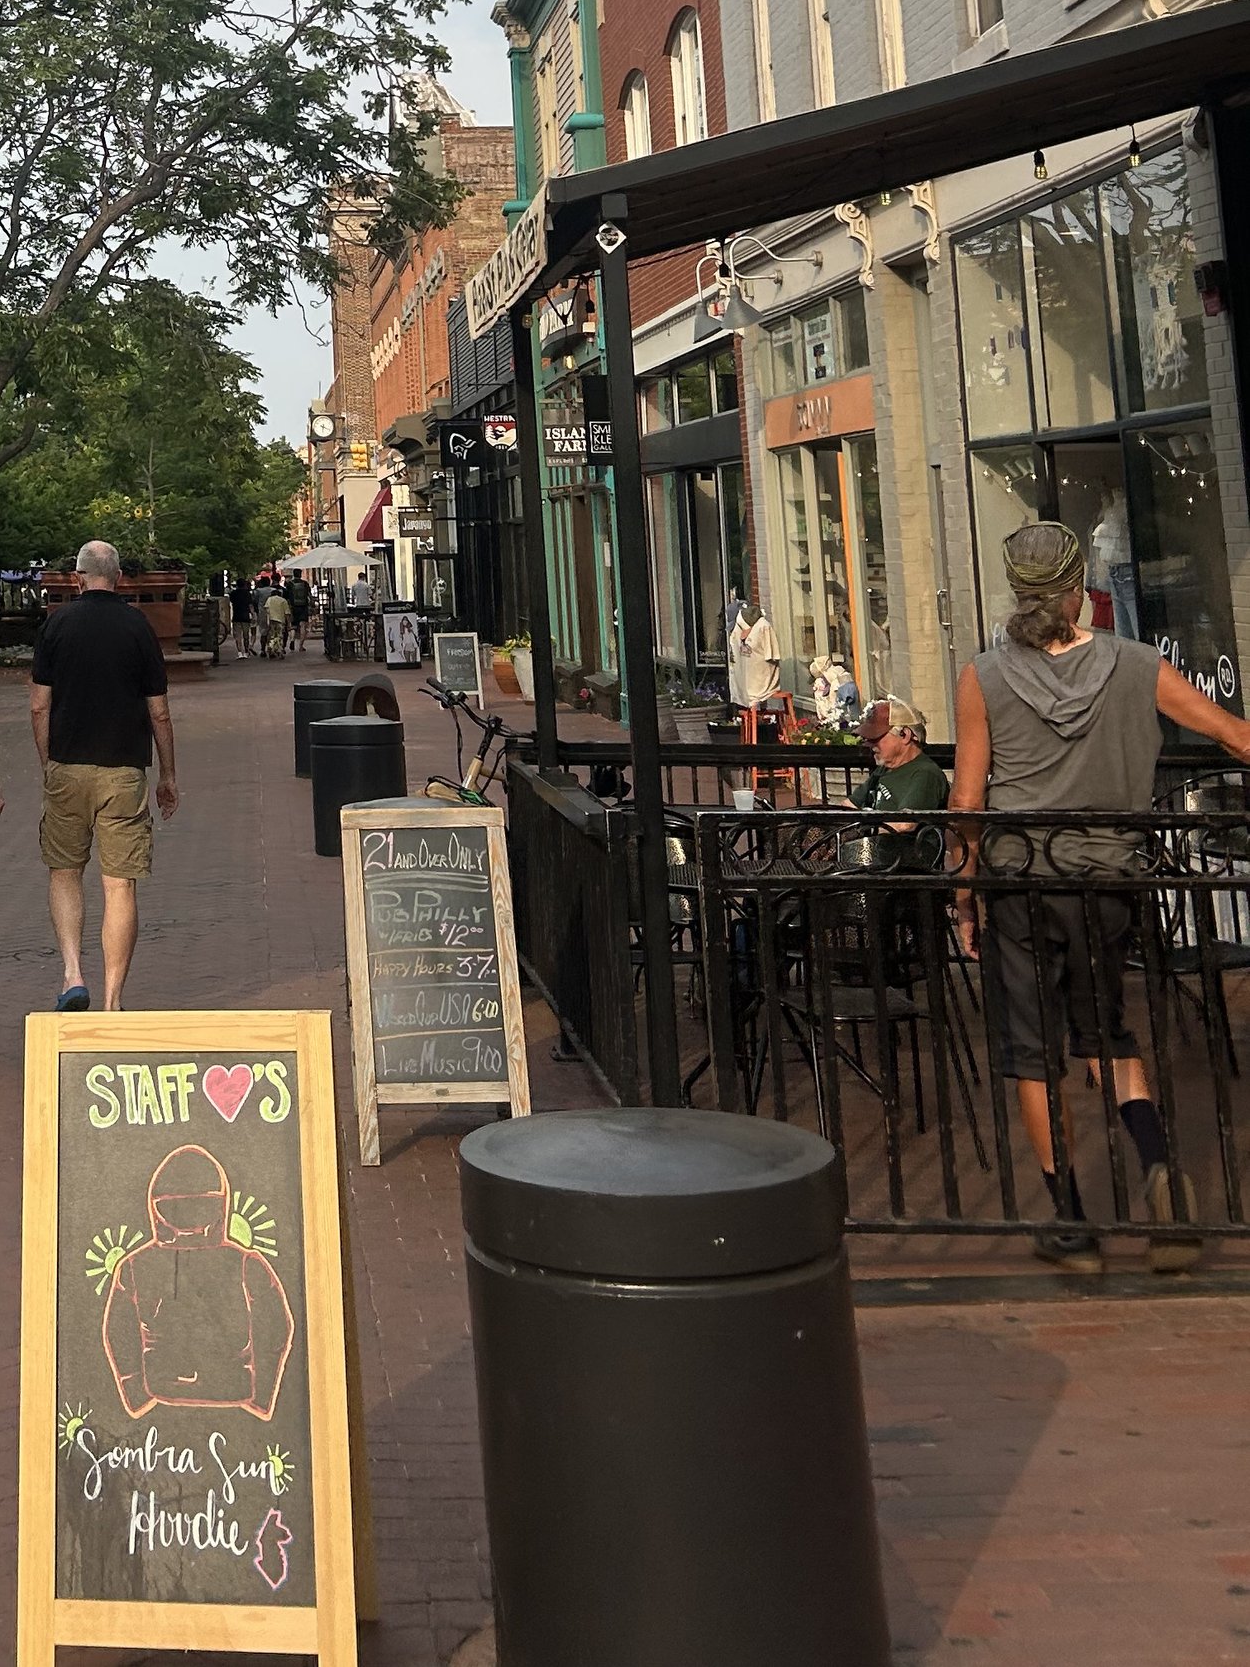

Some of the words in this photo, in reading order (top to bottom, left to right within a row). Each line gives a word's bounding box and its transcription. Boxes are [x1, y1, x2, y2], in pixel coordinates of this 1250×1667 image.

[545, 427, 586, 440] ISLAN
[592, 424, 611, 434] SMI
[593, 435, 612, 444] KLE
[363, 831, 394, 871] 21
[394, 852, 417, 869] AND
[418, 838, 448, 868] OVER
[448, 832, 486, 872] ONLY
[370, 890, 410, 923] PUB
[412, 890, 488, 923] PHILLY
[373, 956, 411, 979] HAPPY
[412, 954, 454, 978] HOURS
[439, 993, 471, 1025] USA
[382, 1044, 418, 1076] LIVE
[420, 1037, 470, 1076] MUSIC
[85, 1062, 199, 1129] STAFF
[76, 1425, 203, 1502] Sombra
[208, 1431, 290, 1497] Sun
[129, 1489, 249, 1556] Hoodie
